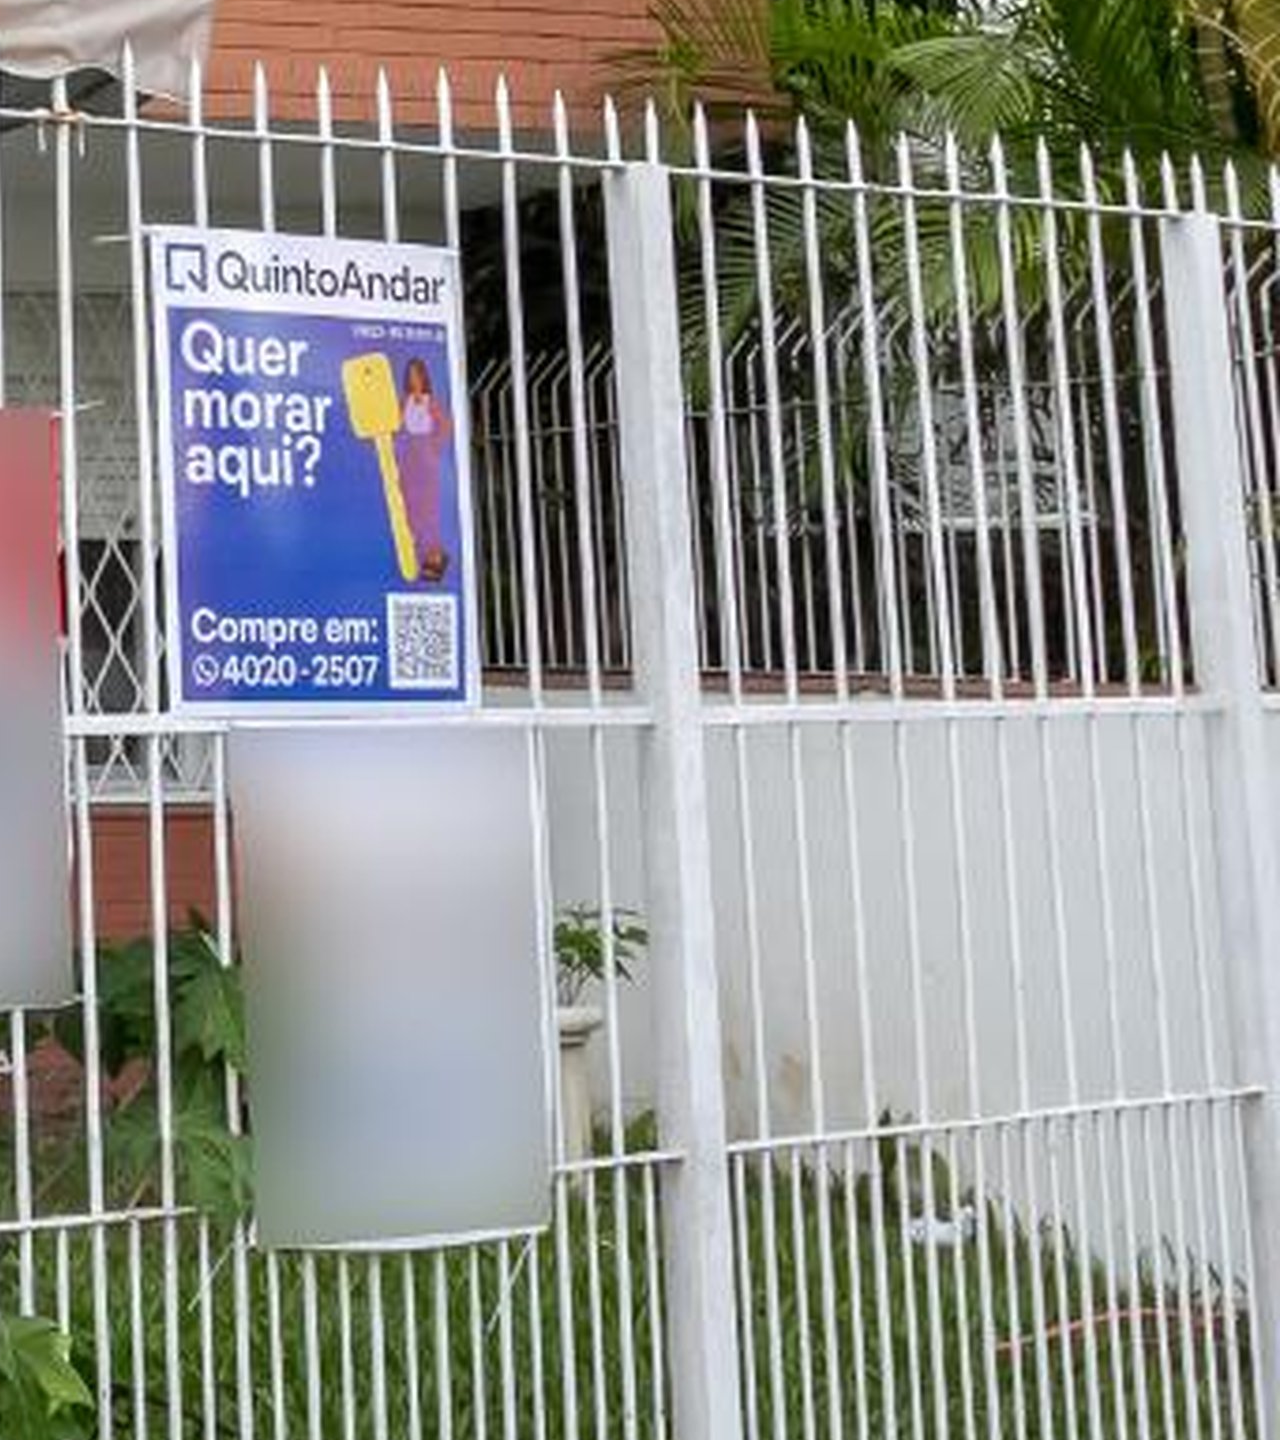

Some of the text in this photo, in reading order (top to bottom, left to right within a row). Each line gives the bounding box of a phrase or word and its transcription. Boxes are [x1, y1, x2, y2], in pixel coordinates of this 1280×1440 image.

[216, 251, 445, 304] QuintoAndar
[180, 320, 308, 376] Quer
[184, 389, 332, 434] morar
[185, 434, 322, 498] aqui?
[192, 607, 379, 652] Compre em:
